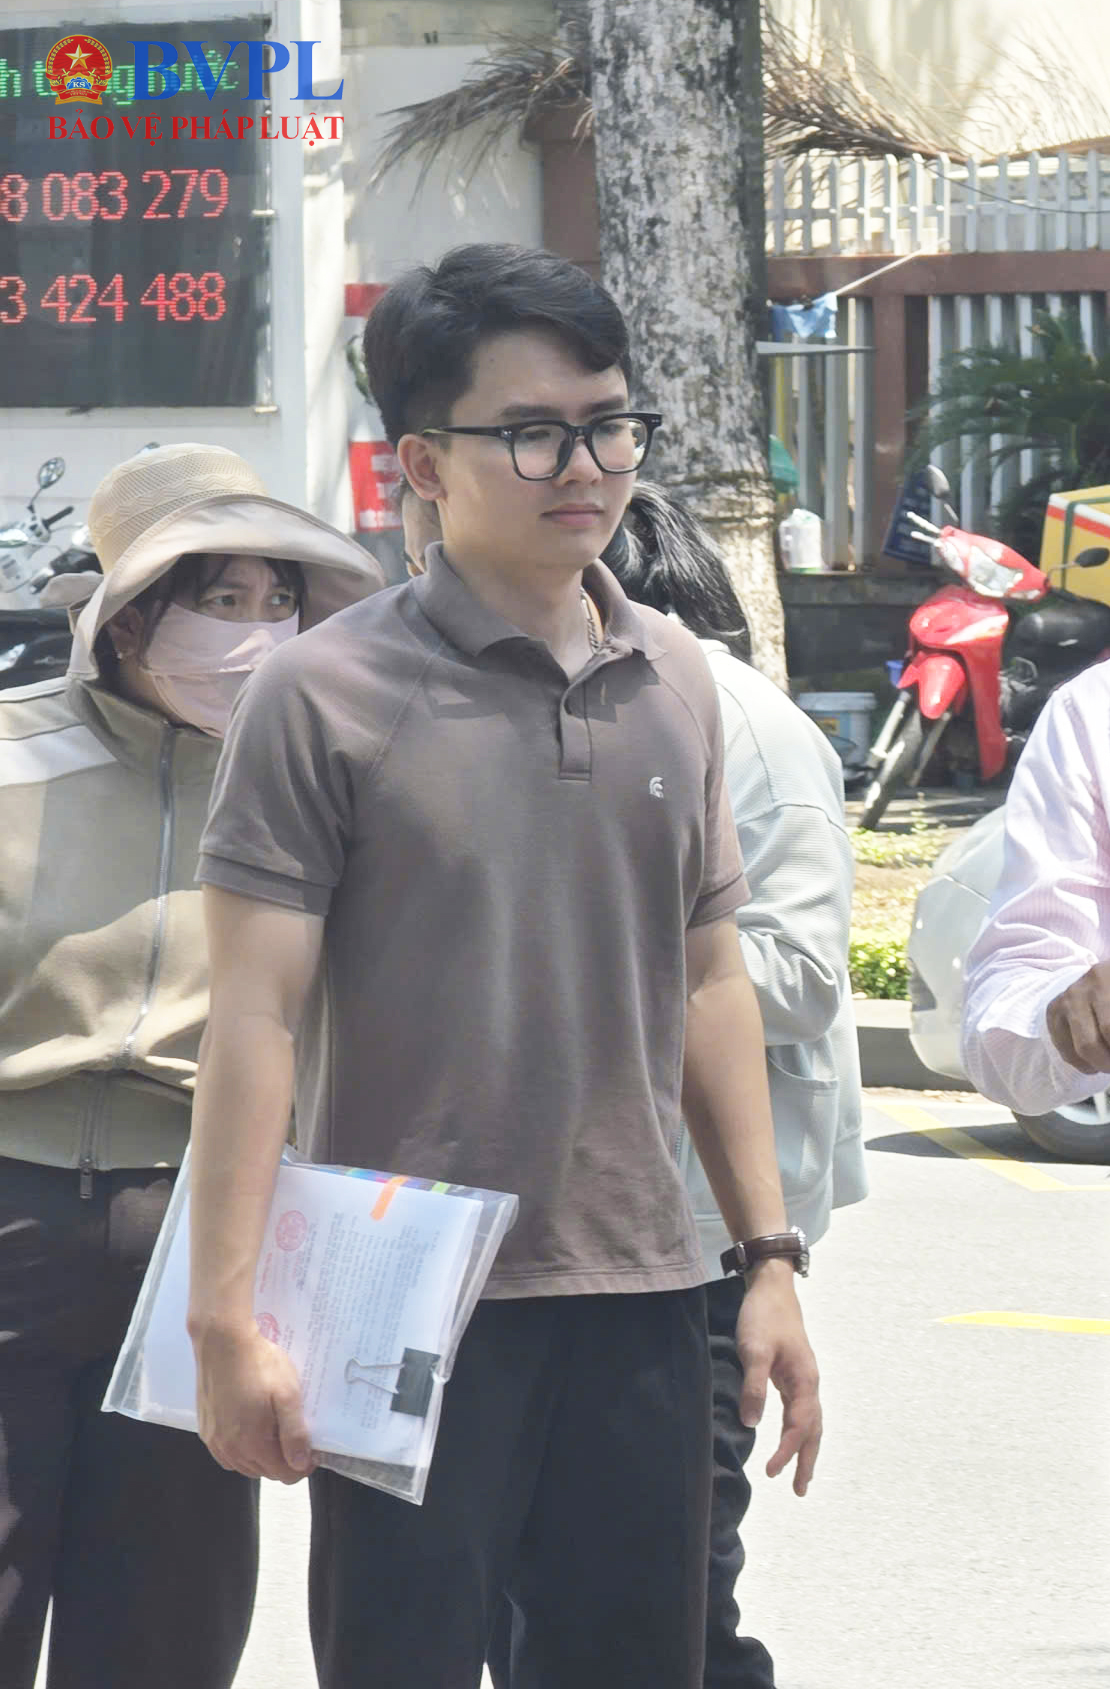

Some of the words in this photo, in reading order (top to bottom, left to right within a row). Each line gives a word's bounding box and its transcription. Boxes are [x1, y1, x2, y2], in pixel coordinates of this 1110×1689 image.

[42, 172, 129, 221] 083
[141, 169, 229, 219] 279
[41, 273, 129, 323] 424
[140, 272, 227, 321] 488
